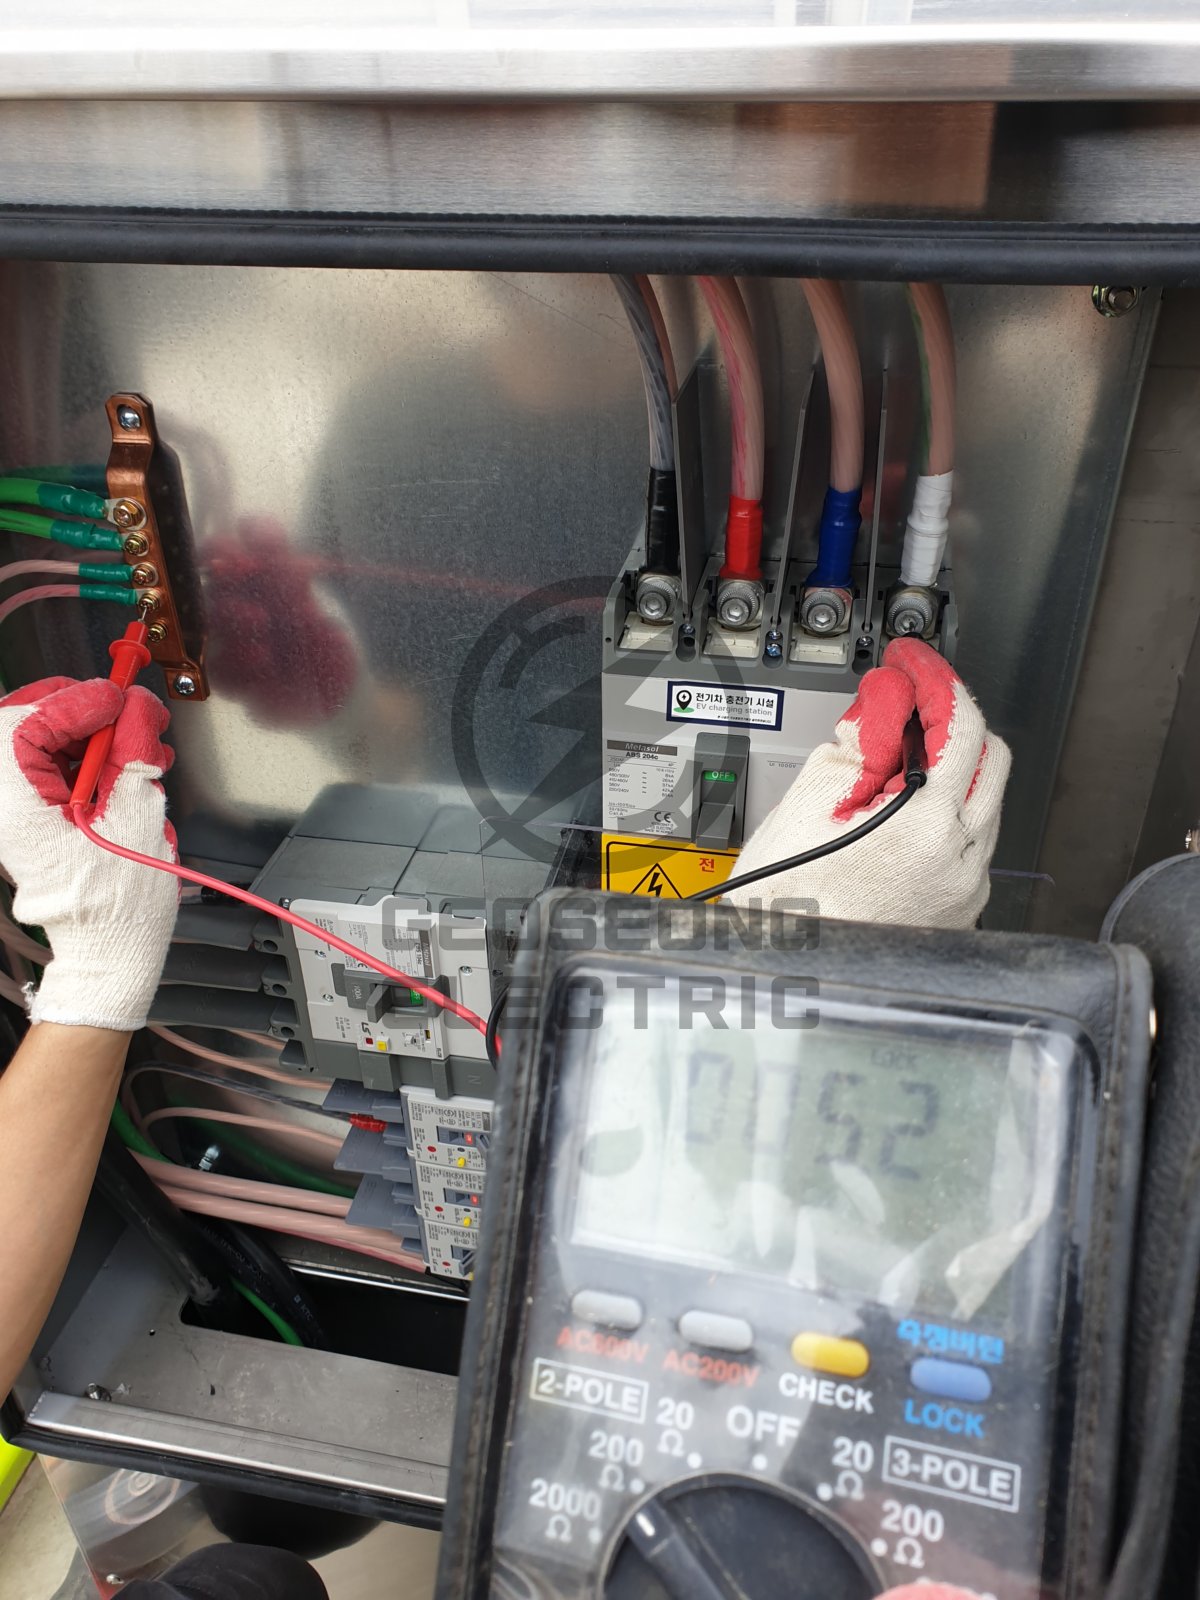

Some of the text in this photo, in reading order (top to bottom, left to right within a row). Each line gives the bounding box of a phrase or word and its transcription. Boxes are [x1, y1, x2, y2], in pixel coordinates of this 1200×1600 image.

[696, 693, 774, 709] 전기차 충전기 시설
[708, 704, 743, 714] charging
[745, 707, 773, 716] station
[624, 743, 660, 753] Metasol
[711, 770, 730, 779] OFF
[654, 811, 672, 823] CE
[699, 857, 715, 873] 전
[662, 1348, 761, 1388] AC200V
[538, 1369, 642, 1414] 2-POLE
[778, 1372, 874, 1414] CHECK
[656, 1397, 694, 1431] 20
[726, 1405, 801, 1447] OFF
[904, 1398, 985, 1439] LOCK
[588, 1430, 644, 1467] 200
[657, 1428, 685, 1457] Ω
[831, 1436, 875, 1473] 20
[599, 1463, 625, 1492] Ω
[834, 1470, 865, 1499] Ω
[891, 1448, 1012, 1501] 3-POLE
[529, 1478, 601, 1521] 2000
[545, 1514, 572, 1542] Ω
[880, 1499, 944, 1542] 200
[893, 1537, 925, 1569] Ω
